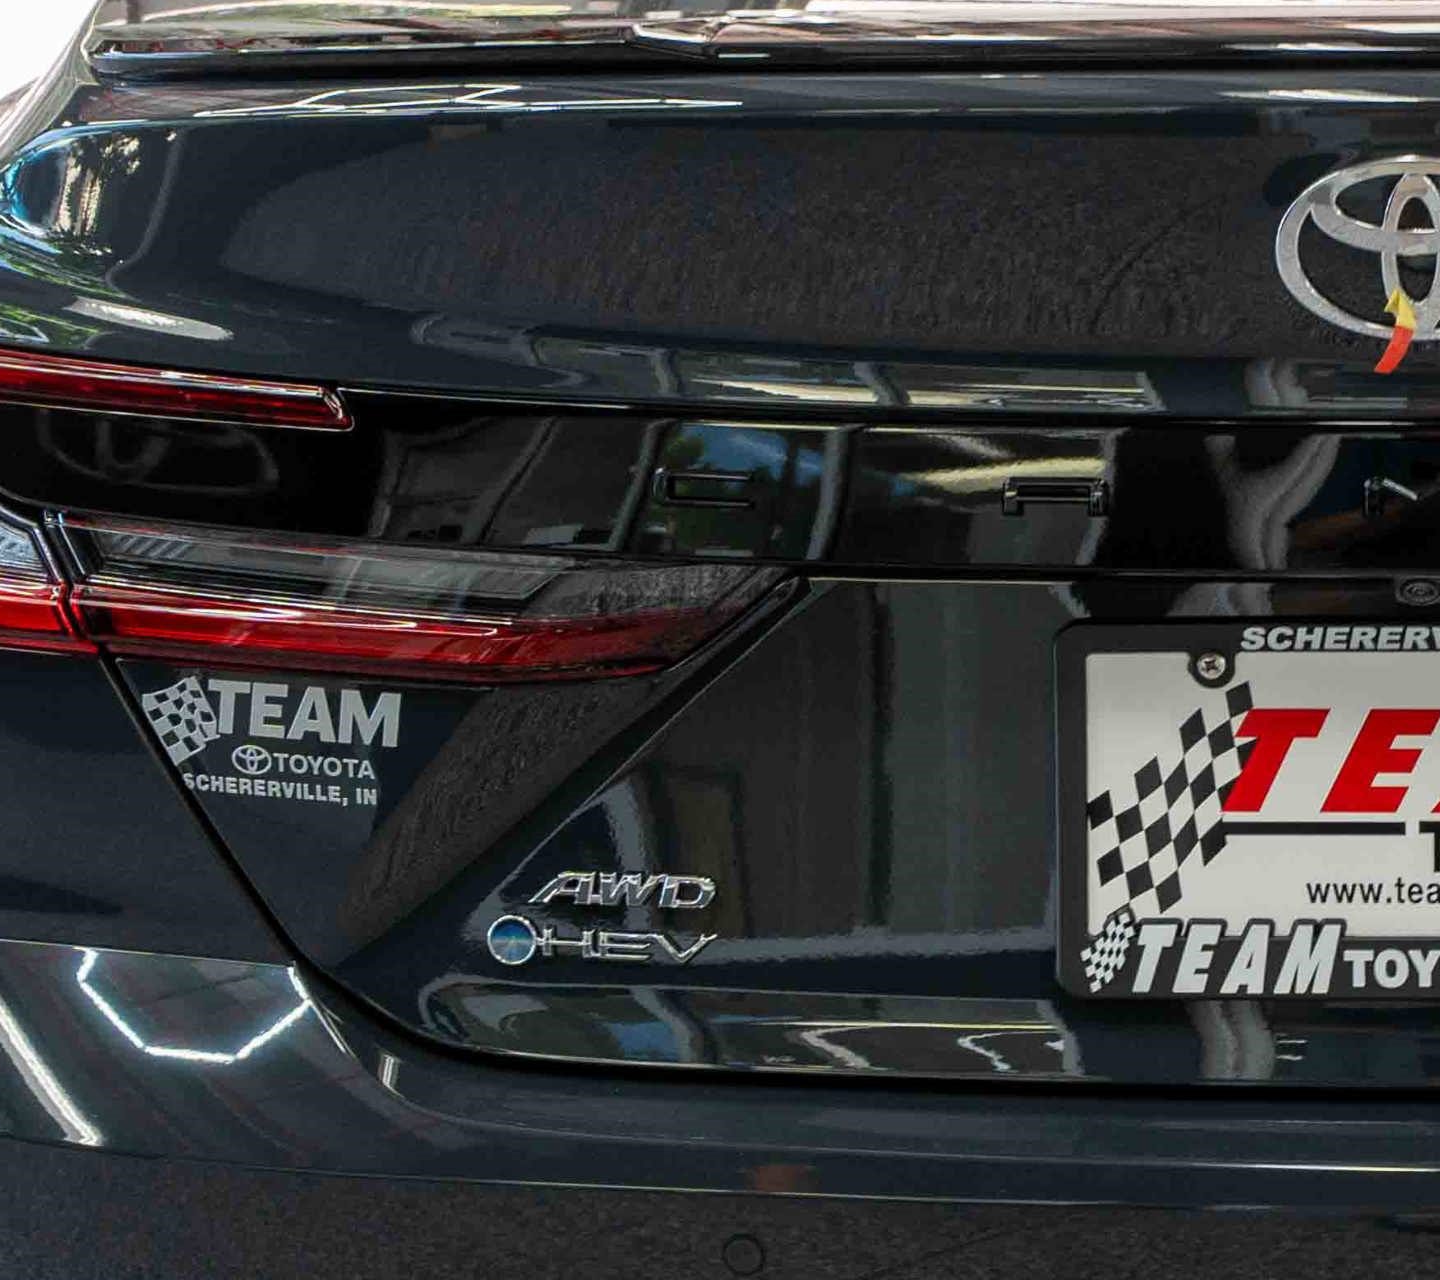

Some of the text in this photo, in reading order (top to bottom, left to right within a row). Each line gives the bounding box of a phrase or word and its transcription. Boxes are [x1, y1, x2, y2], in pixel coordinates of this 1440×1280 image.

[208, 678, 402, 748] TEAM
[273, 752, 376, 781] TOYOTA
[182, 771, 378, 806] SCHERERVILLE, IN
[528, 870, 717, 909] AWD
[537, 925, 719, 965] HEV
[1131, 923, 1345, 995] TEAM
